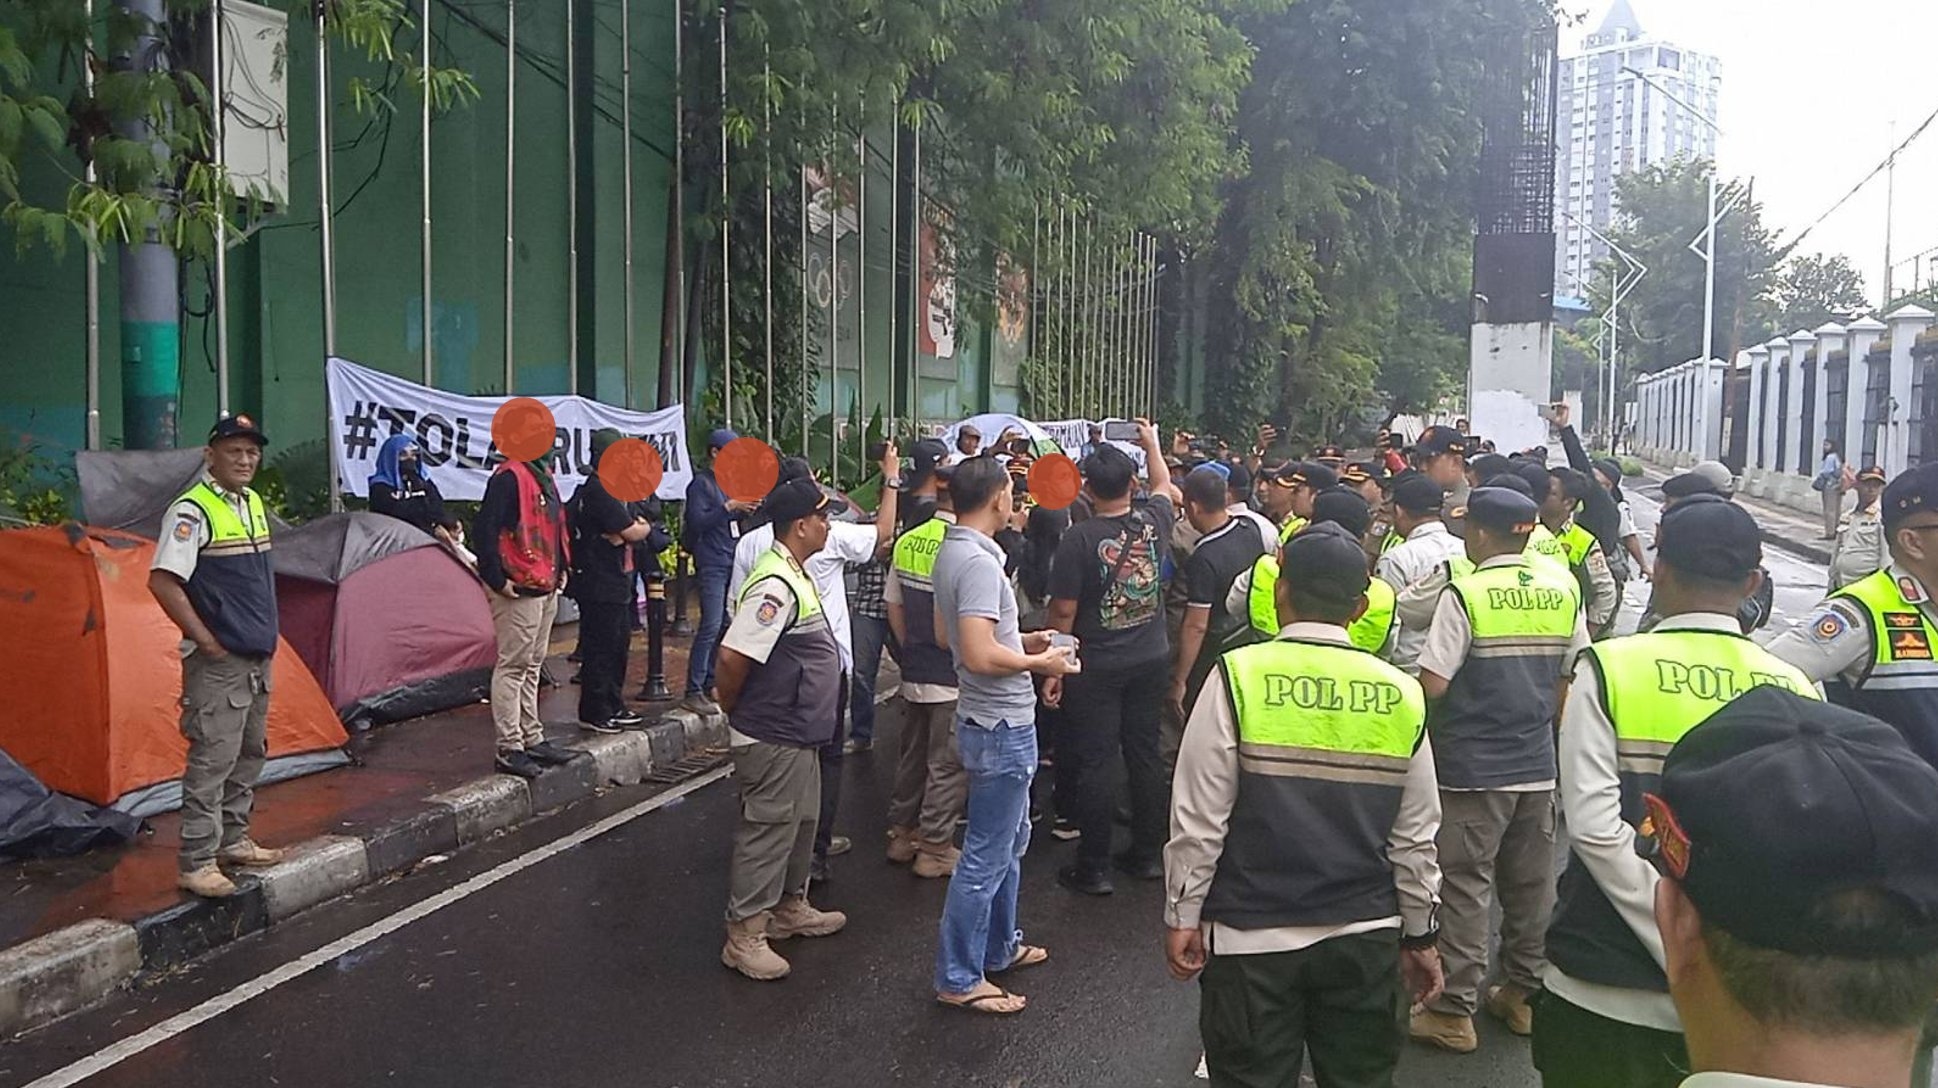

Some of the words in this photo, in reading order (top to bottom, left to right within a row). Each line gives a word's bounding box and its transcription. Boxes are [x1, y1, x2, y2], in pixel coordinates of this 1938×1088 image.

[343, 400, 508, 470] #TOL
[1487, 588, 1534, 610] POL
[1535, 588, 1563, 610] PP
[1264, 675, 1343, 710] POL
[1350, 680, 1402, 714] PP
[1655, 659, 1743, 702] POL
